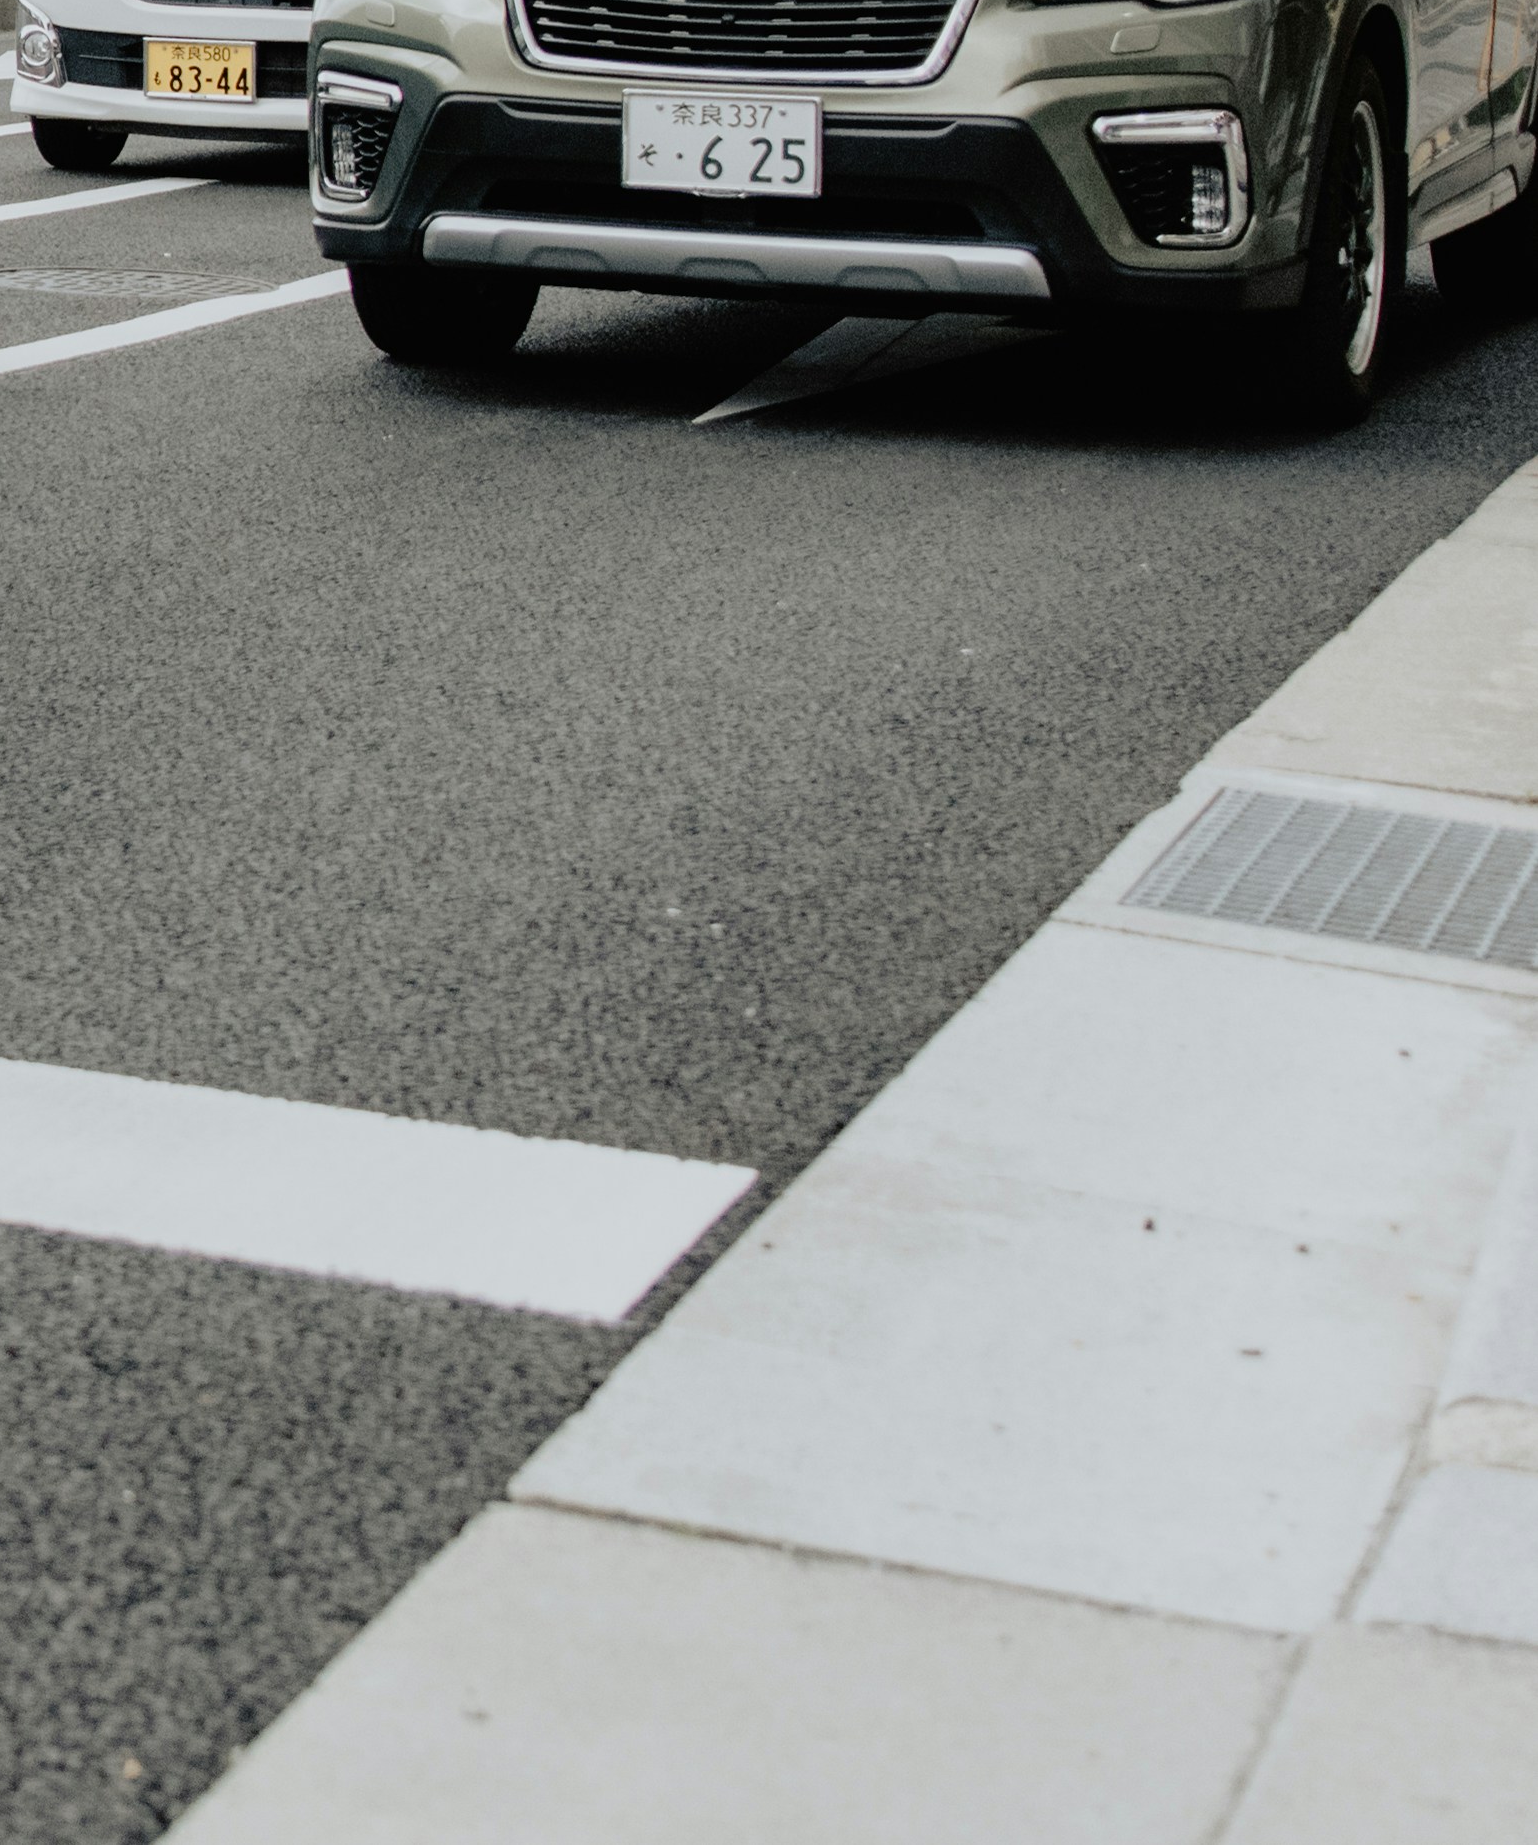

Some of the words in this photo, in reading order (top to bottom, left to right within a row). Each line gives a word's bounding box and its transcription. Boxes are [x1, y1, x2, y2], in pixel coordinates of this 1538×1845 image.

[154, 71, 162, 86] も
[169, 65, 249, 95] 83-44
[638, 143, 658, 167] そ
